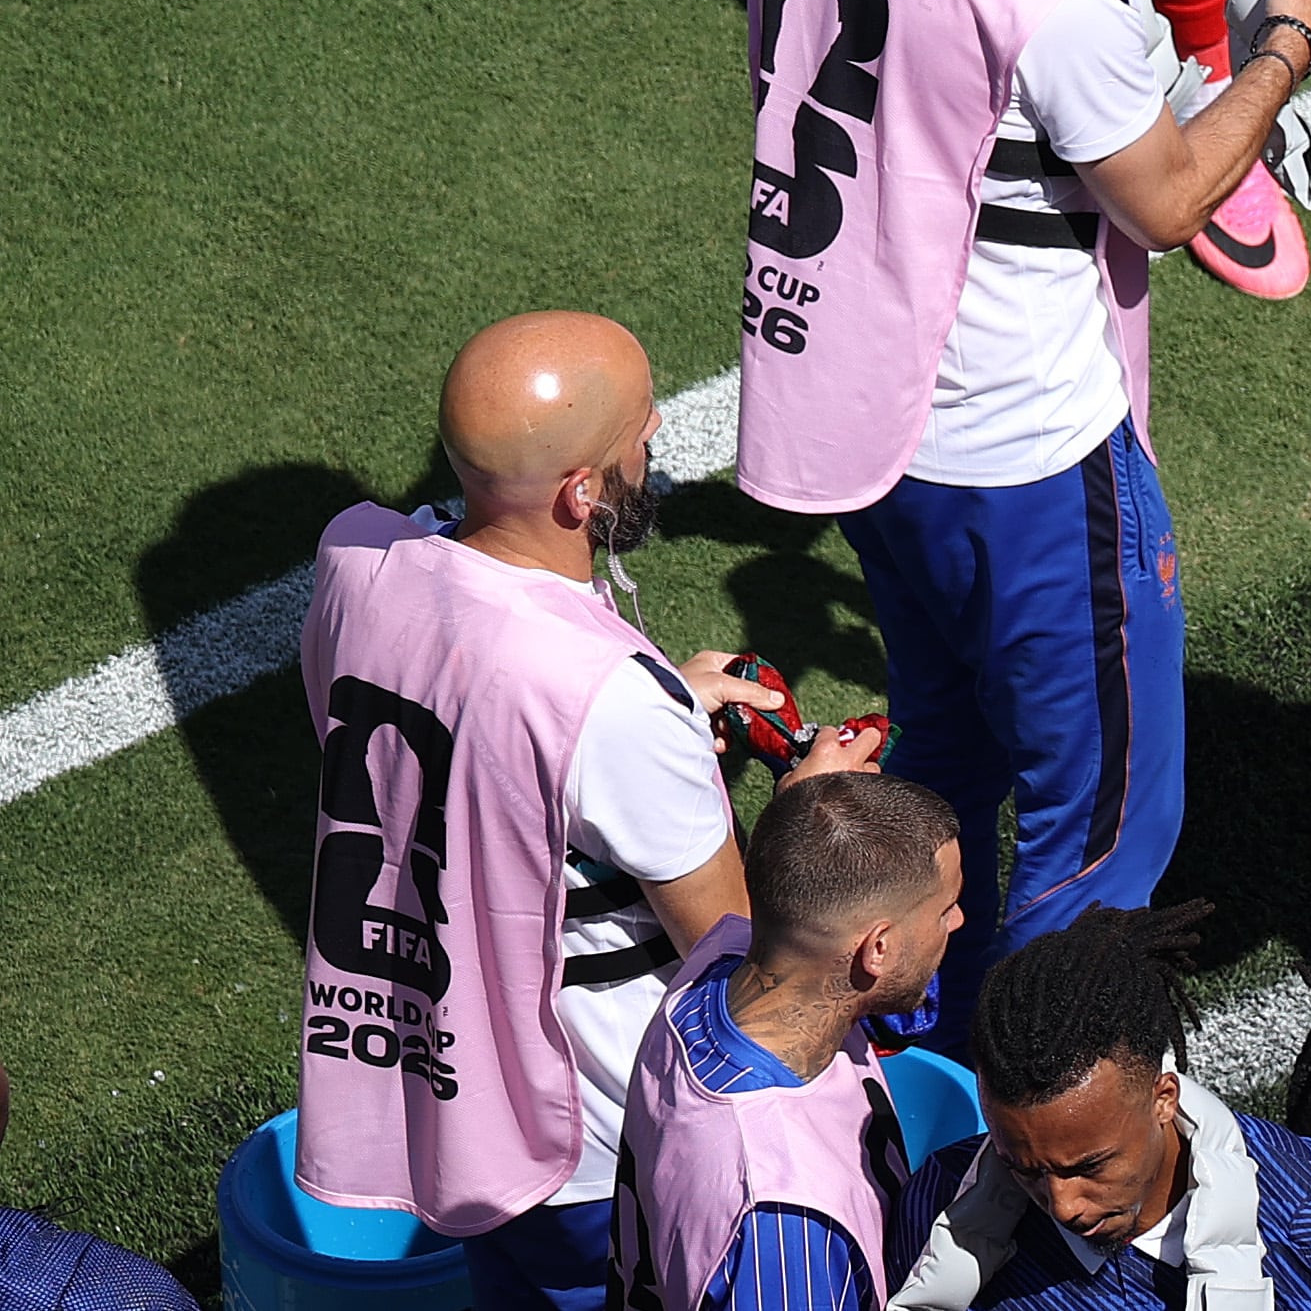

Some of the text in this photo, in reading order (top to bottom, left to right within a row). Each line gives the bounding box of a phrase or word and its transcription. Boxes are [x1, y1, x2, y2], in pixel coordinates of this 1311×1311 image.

[758, 265, 821, 307] CUP
[361, 919, 432, 972] FIFA
[309, 979, 422, 1026] WORLD
